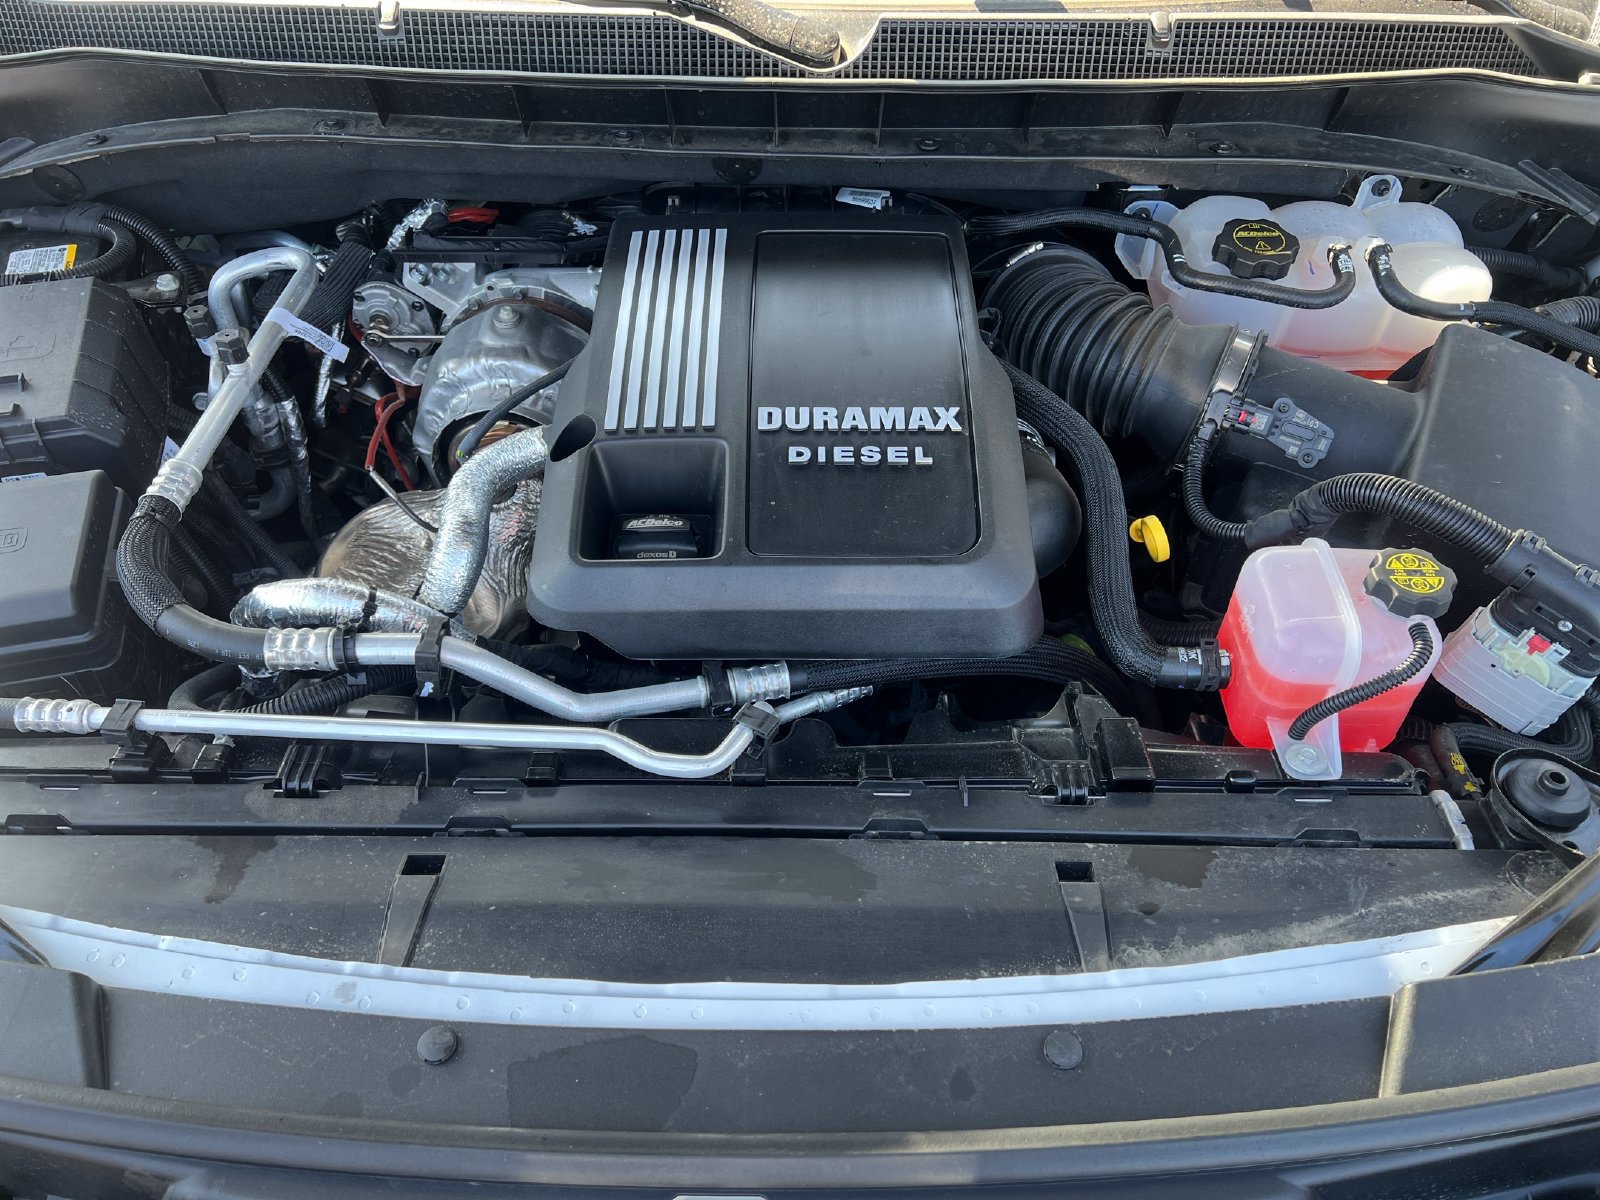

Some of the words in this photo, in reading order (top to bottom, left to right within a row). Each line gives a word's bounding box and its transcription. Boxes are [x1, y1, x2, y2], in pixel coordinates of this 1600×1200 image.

[1235, 230, 1281, 238] ACDelco
[757, 406, 963, 432] DURAMAX
[788, 446, 934, 465] DIESEL
[626, 518, 684, 529] ACDelco
